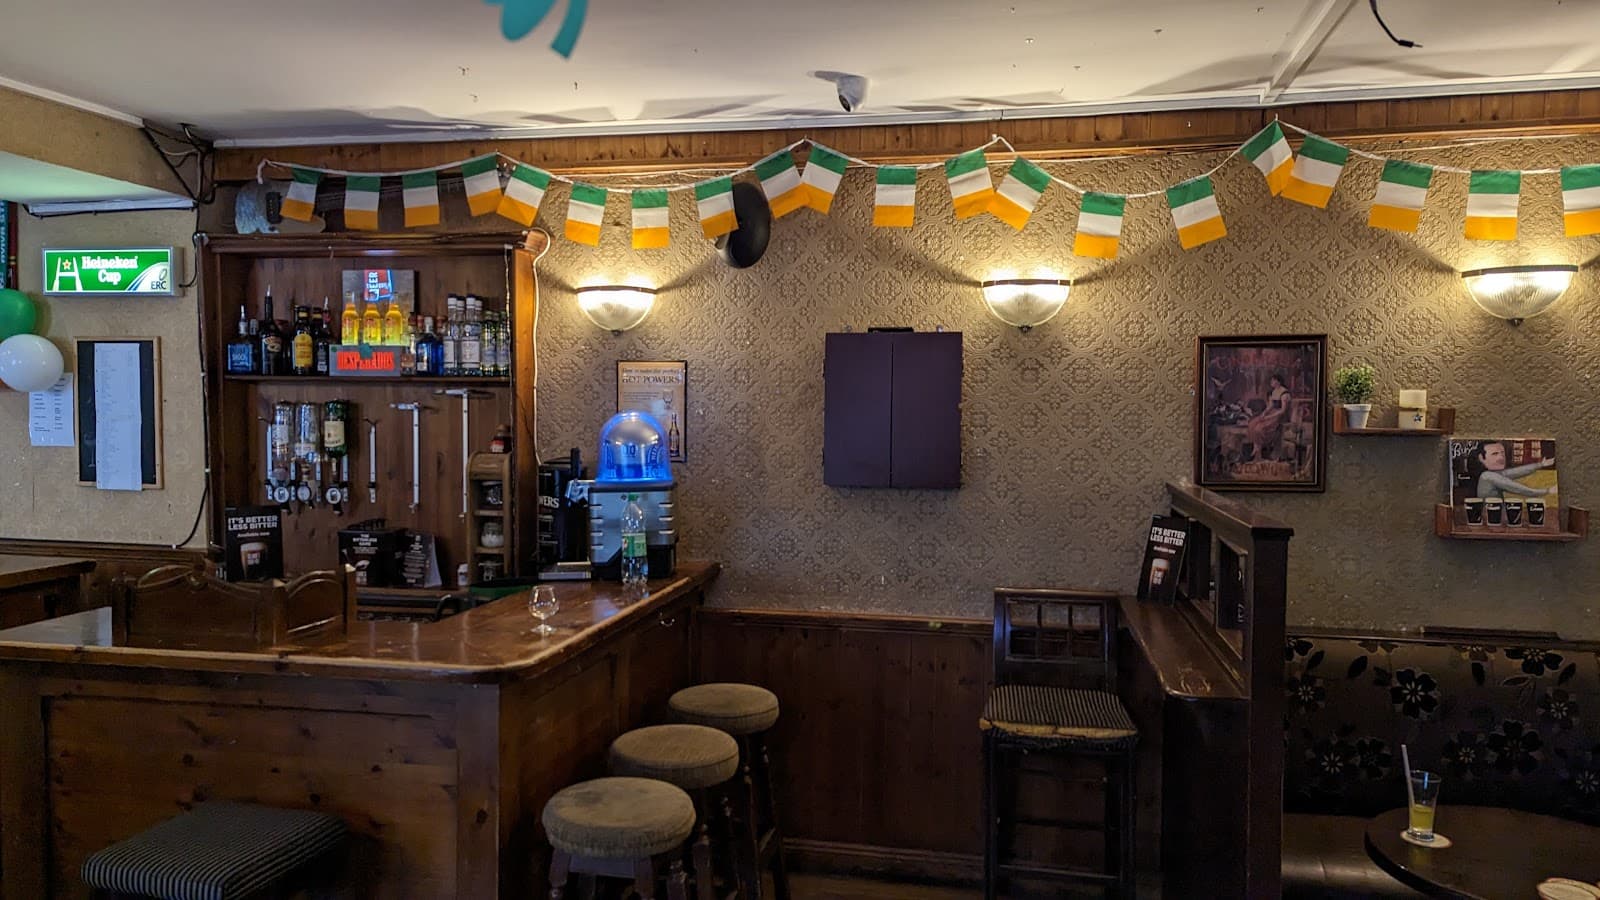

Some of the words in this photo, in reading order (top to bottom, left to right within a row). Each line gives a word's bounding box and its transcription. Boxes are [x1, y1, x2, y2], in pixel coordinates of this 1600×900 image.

[82, 256, 138, 269] Heineken
[98, 269, 121, 285] Cup
[151, 281, 167, 290] ERC
[245, 515, 278, 523] BETTER
[228, 523, 248, 531] LESS
[1163, 528, 1185, 539] BETTER
[1163, 536, 1183, 546] BITTER
